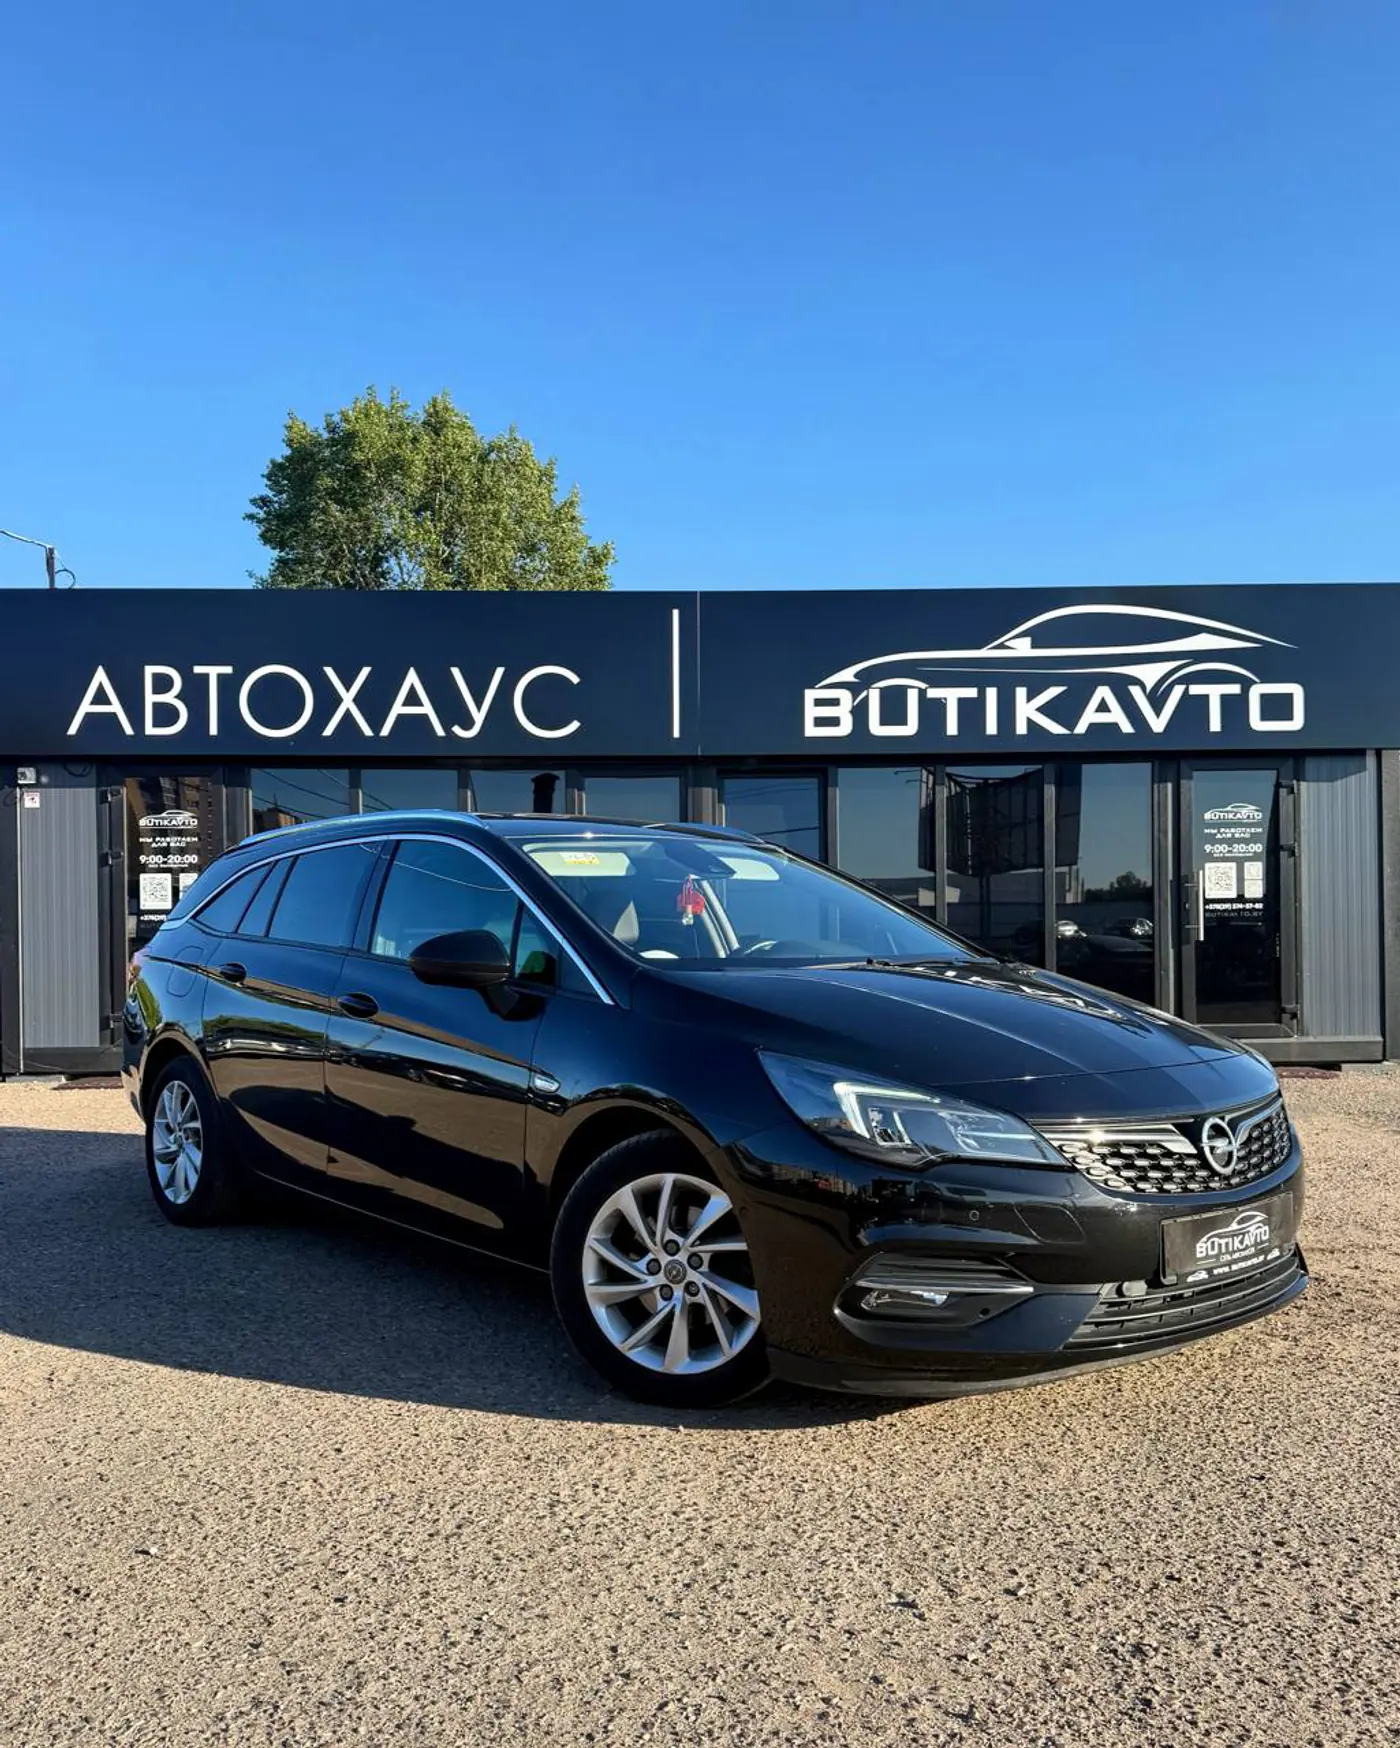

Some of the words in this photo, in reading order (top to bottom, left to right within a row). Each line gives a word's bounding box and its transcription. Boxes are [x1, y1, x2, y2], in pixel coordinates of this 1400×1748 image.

[66, 663, 582, 739] АВТОХАУС
[804, 681, 1305, 738] BUTIKAVTO
[1204, 811, 1262, 820] BUTIKAVTO
[139, 818, 198, 827] BUTIKAVTO
[1204, 843, 1263, 853] 9:00-20:00
[139, 854, 198, 864] 9:00-20:00
[1196, 1225, 1269, 1258] BUTIKAVTO
